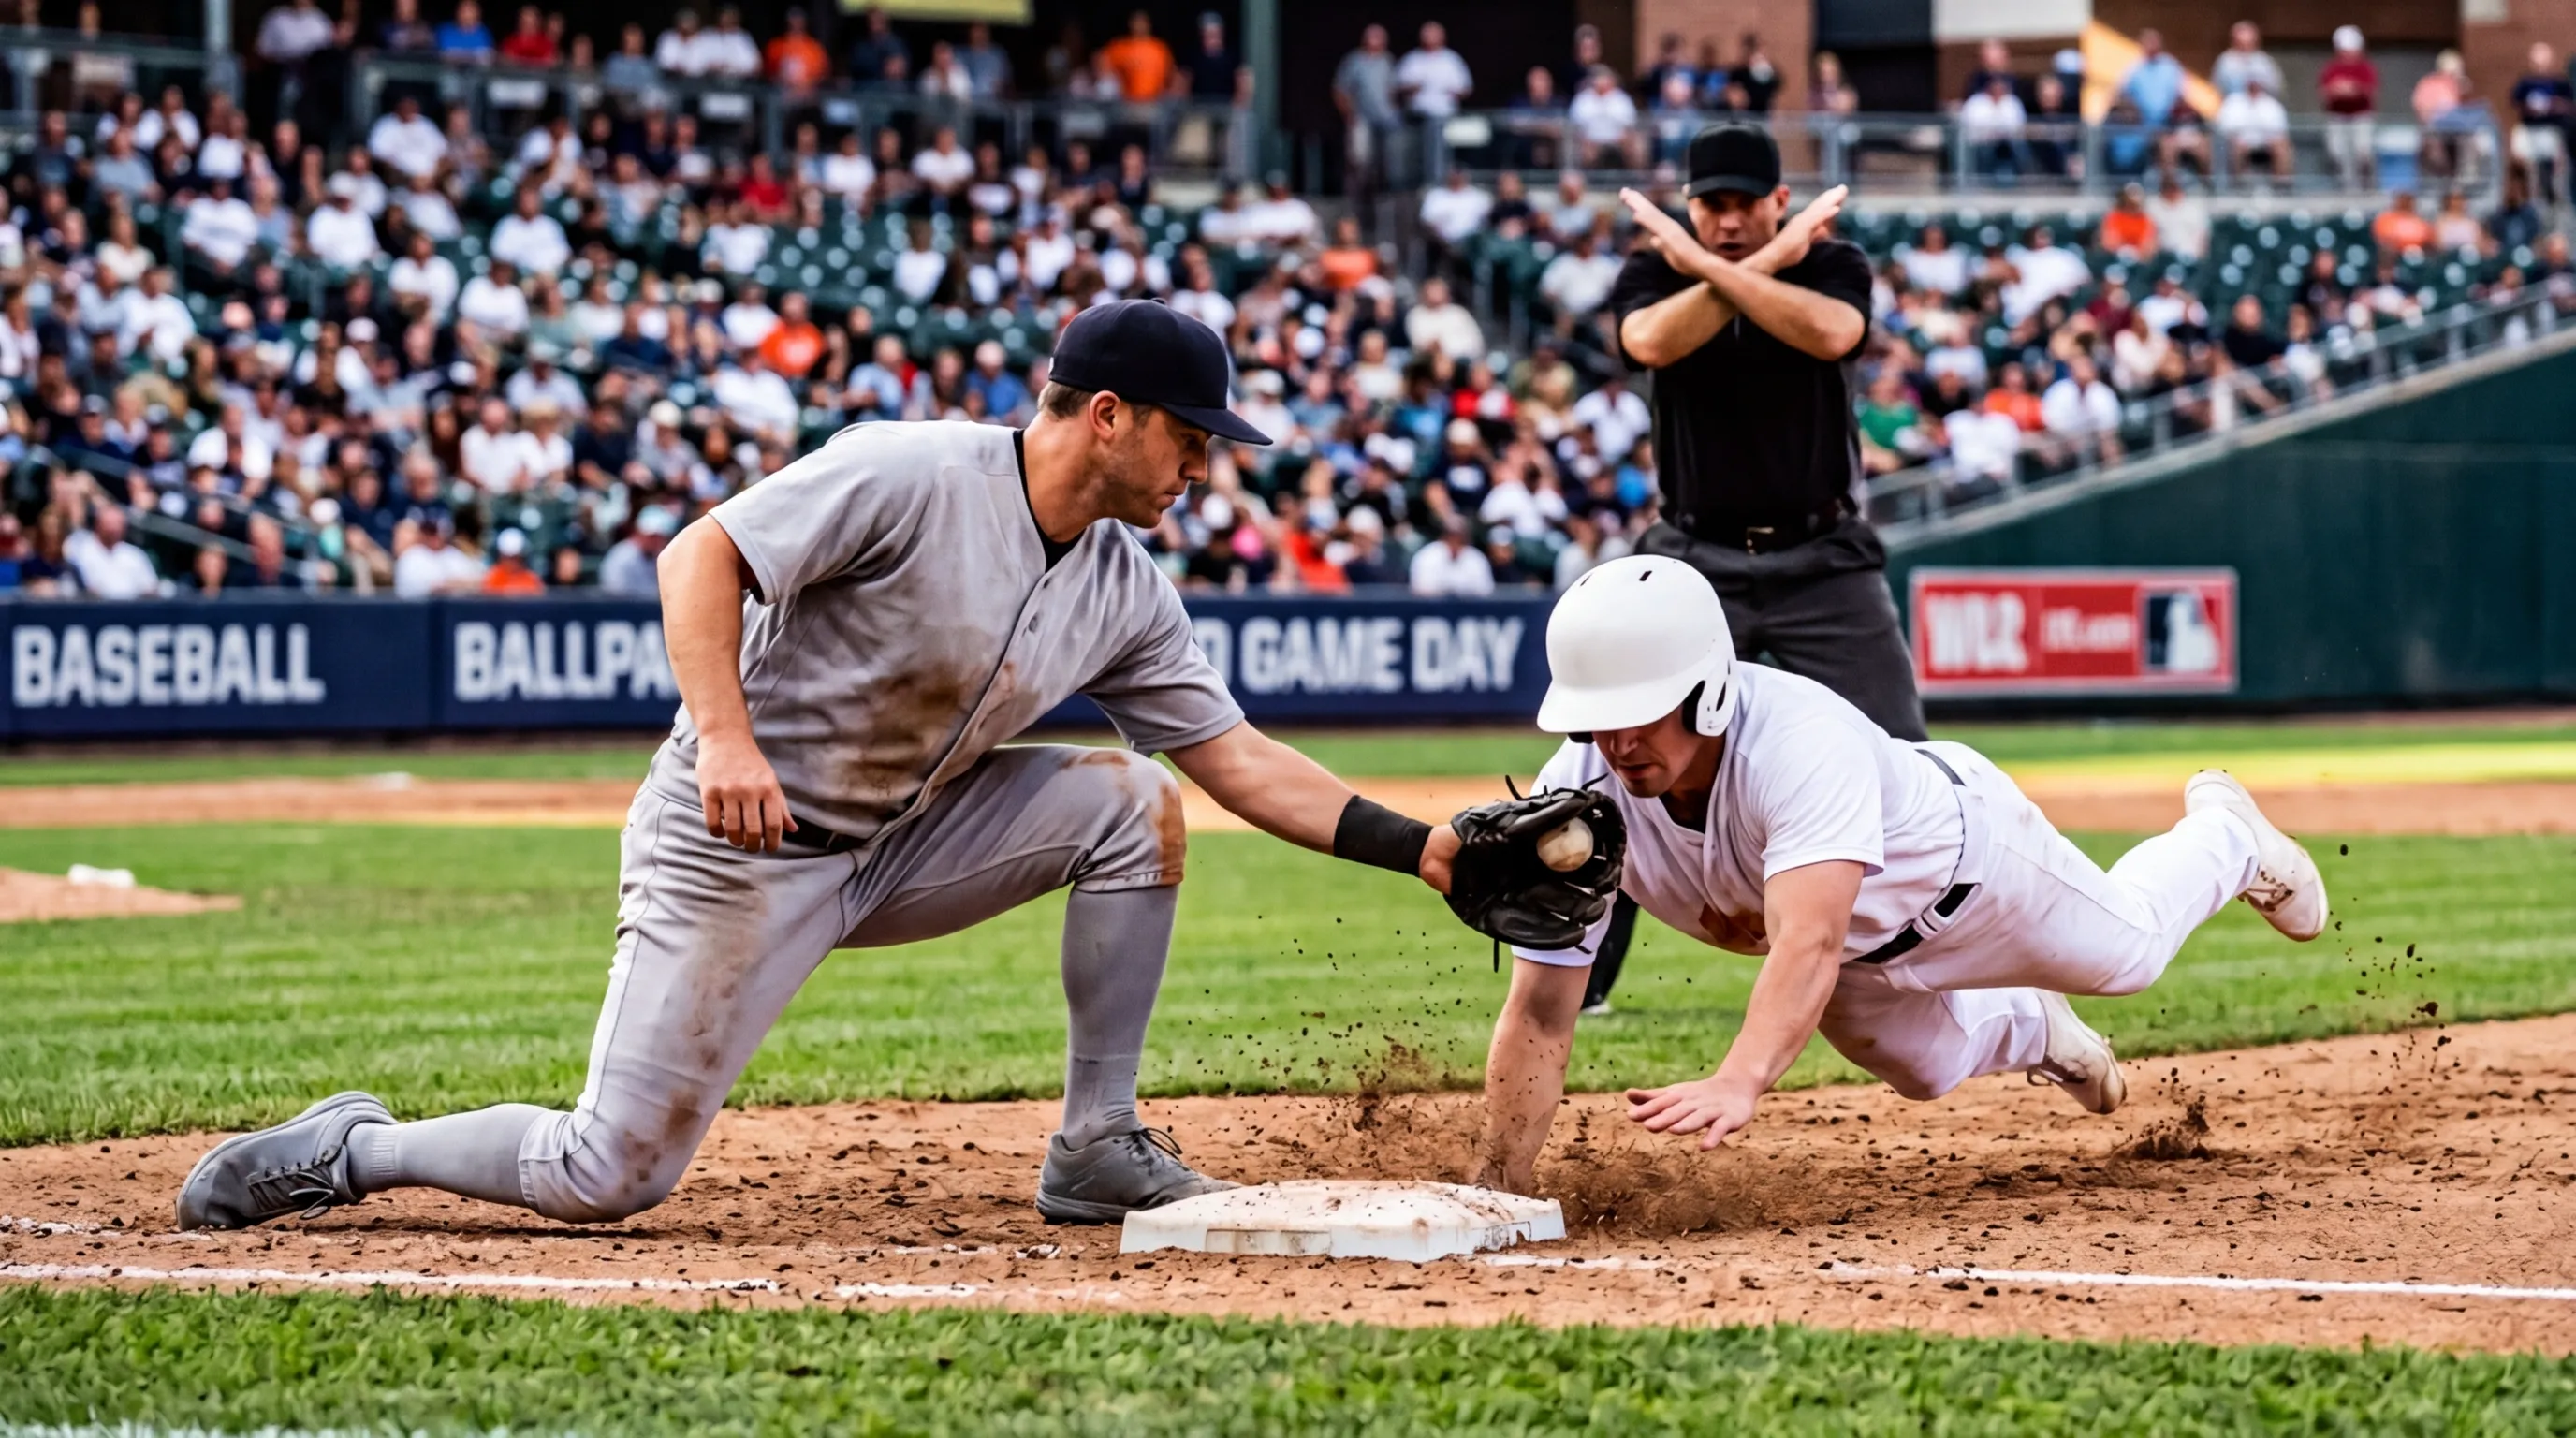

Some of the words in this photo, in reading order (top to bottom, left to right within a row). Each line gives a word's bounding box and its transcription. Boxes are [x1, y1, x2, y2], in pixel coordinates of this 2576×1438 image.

[13, 624, 325, 706] BASEBALL
[1240, 617, 1403, 693] GAME
[1411, 617, 1523, 691] DAY
